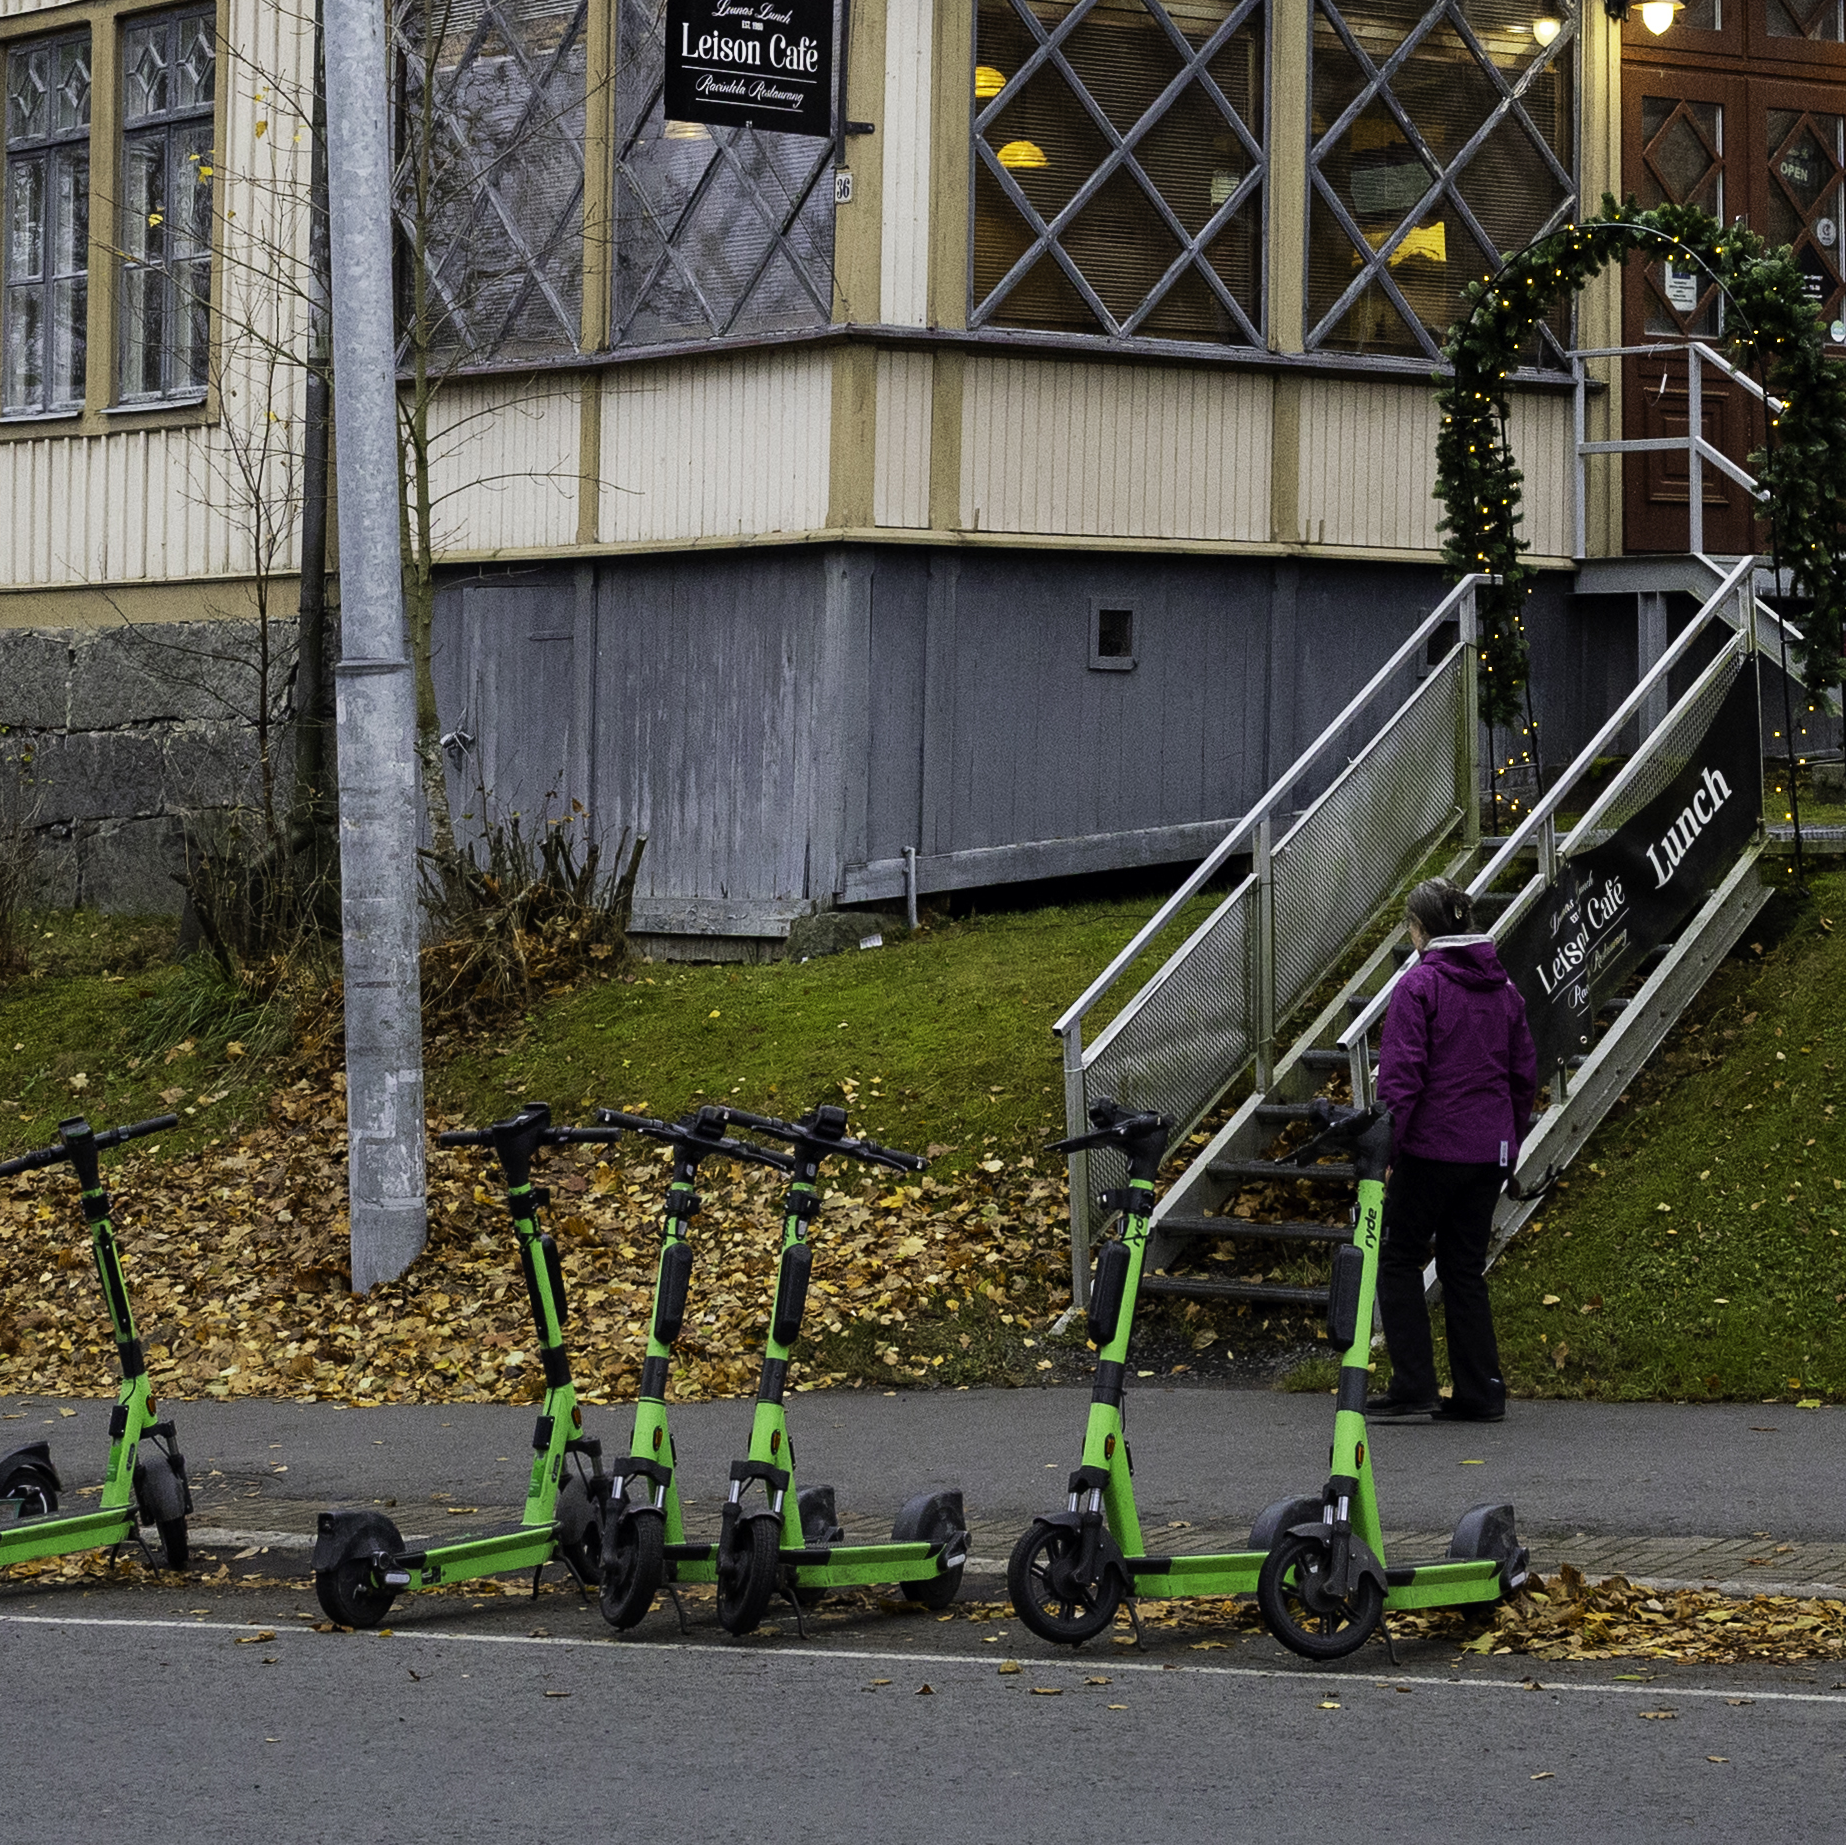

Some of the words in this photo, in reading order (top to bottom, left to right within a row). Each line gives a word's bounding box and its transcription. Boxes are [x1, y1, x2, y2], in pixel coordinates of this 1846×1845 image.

[754, 2, 793, 24] Lunch
[681, 22, 761, 66] Leison
[769, 33, 818, 72] Café
[748, 80, 804, 109] Restaurang
[837, 178, 850, 199] 36
[1780, 162, 1808, 182] OPEN
[1645, 766, 1733, 890] Lunch
[1587, 875, 1625, 929] Café
[1364, 1207, 1377, 1249] ryde
